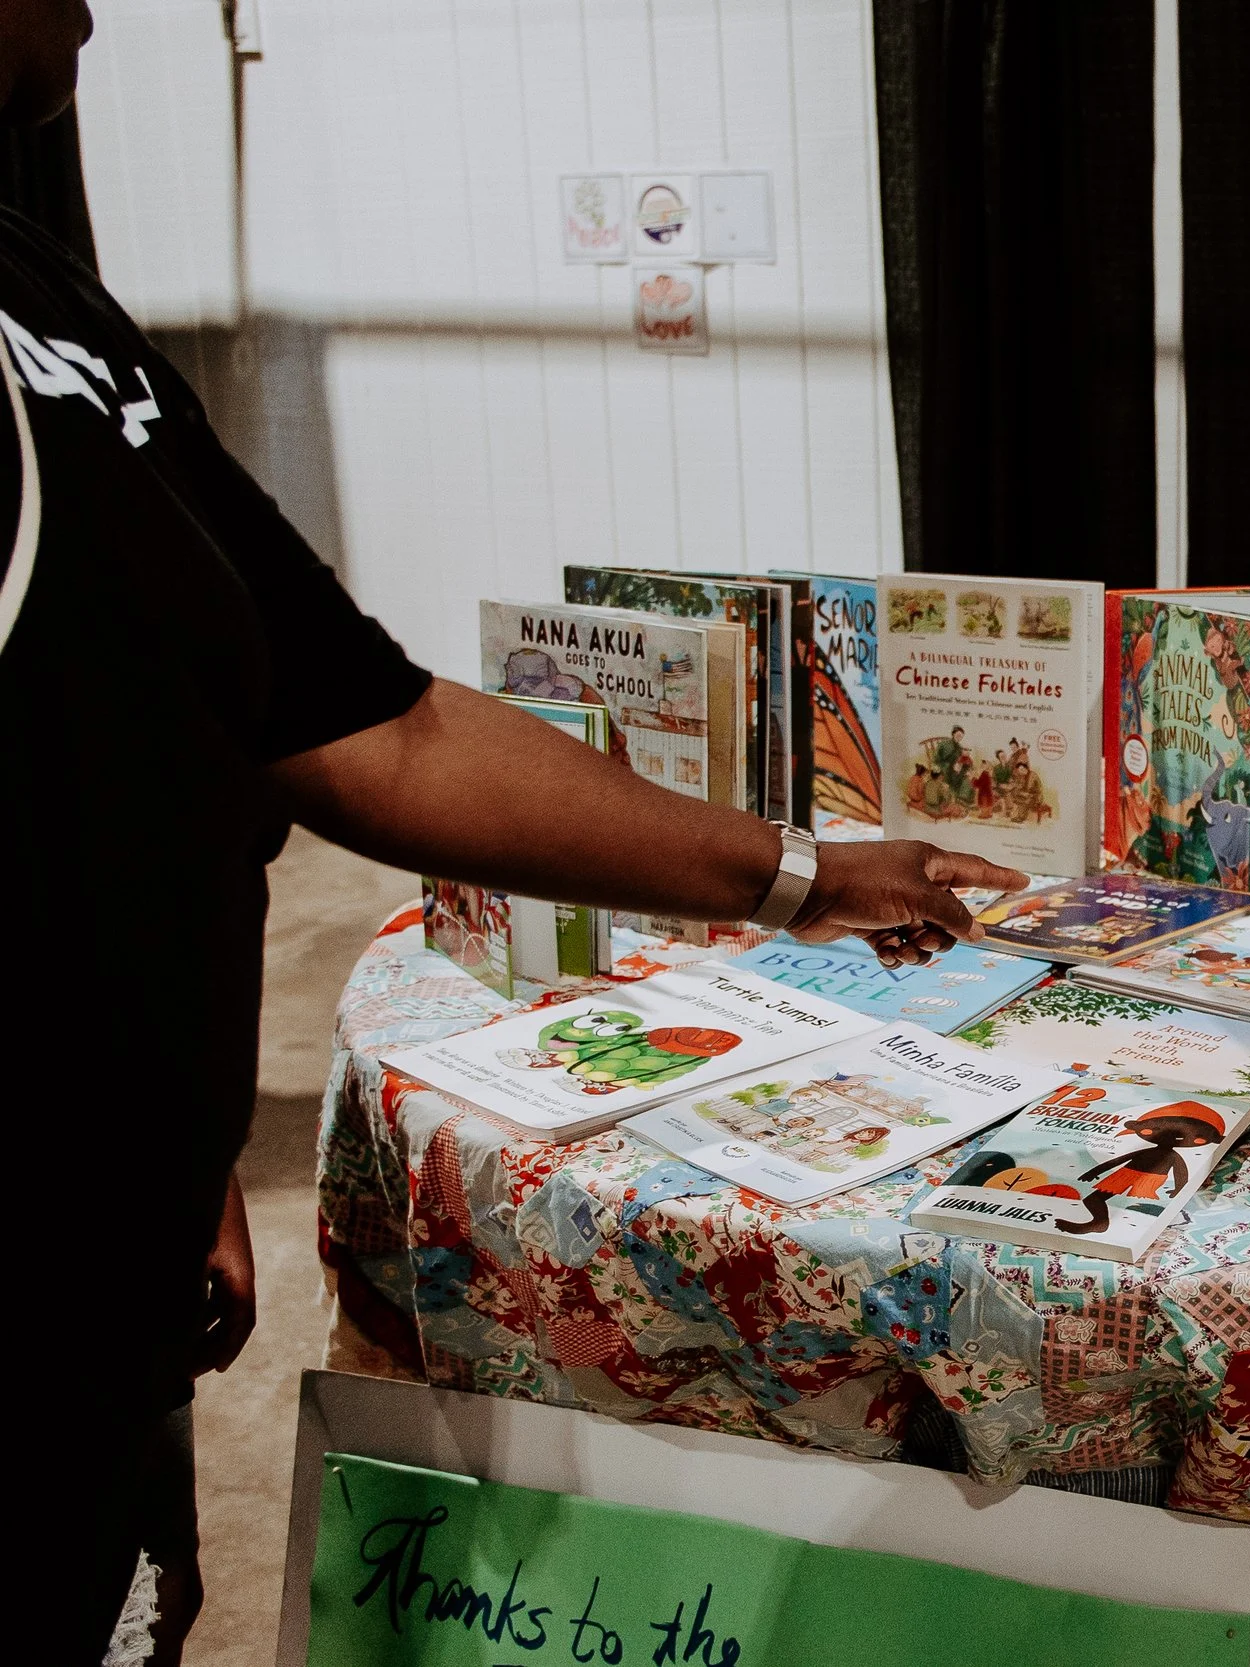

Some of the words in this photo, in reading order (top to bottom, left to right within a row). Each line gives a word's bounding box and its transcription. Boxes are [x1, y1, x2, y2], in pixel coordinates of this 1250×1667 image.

[817, 590, 876, 637] SEÑOR
[521, 616, 579, 650] NANA
[589, 626, 645, 659] AKUA
[565, 652, 590, 667] GOES
[594, 656, 606, 670] TO
[910, 651, 916, 662] A
[920, 652, 974, 667] BILINGUAL
[979, 655, 1030, 672] TREASURY
[1034, 661, 1047, 672] OF
[1153, 650, 1213, 700] ANIMAL
[596, 671, 654, 699] SCHOOL
[895, 665, 970, 690] Chinese
[978, 673, 1063, 698] Folktales
[1160, 690, 1203, 727] TALES
[1151, 725, 1178, 754] FROM
[1180, 727, 1212, 767] INDIA
[758, 952, 918, 983] BORN
[770, 972, 908, 1002] FREE
[709, 976, 764, 1003] Turtle
[766, 1000, 839, 1029] Jumps!
[1132, 1030, 1160, 1041] the
[1166, 1035, 1220, 1053] World
[1158, 1024, 1228, 1043] Around
[879, 1034, 946, 1070] Minha
[944, 1062, 1022, 1092] Família
[1111, 1046, 1184, 1067] Friends
[1138, 1041, 1178, 1056] with
[1040, 1085, 1107, 1109] 12
[1026, 1105, 1126, 1126] BRAZILIAN
[1035, 1117, 1120, 1135] FOLKLORE
[1083, 1140, 1116, 1151] English
[931, 1197, 1000, 1218] LUANNA
[998, 1203, 1053, 1226] JALES
[353, 1505, 552, 1651] Thanks
[570, 1576, 623, 1664] to
[650, 1583, 741, 1667] the
